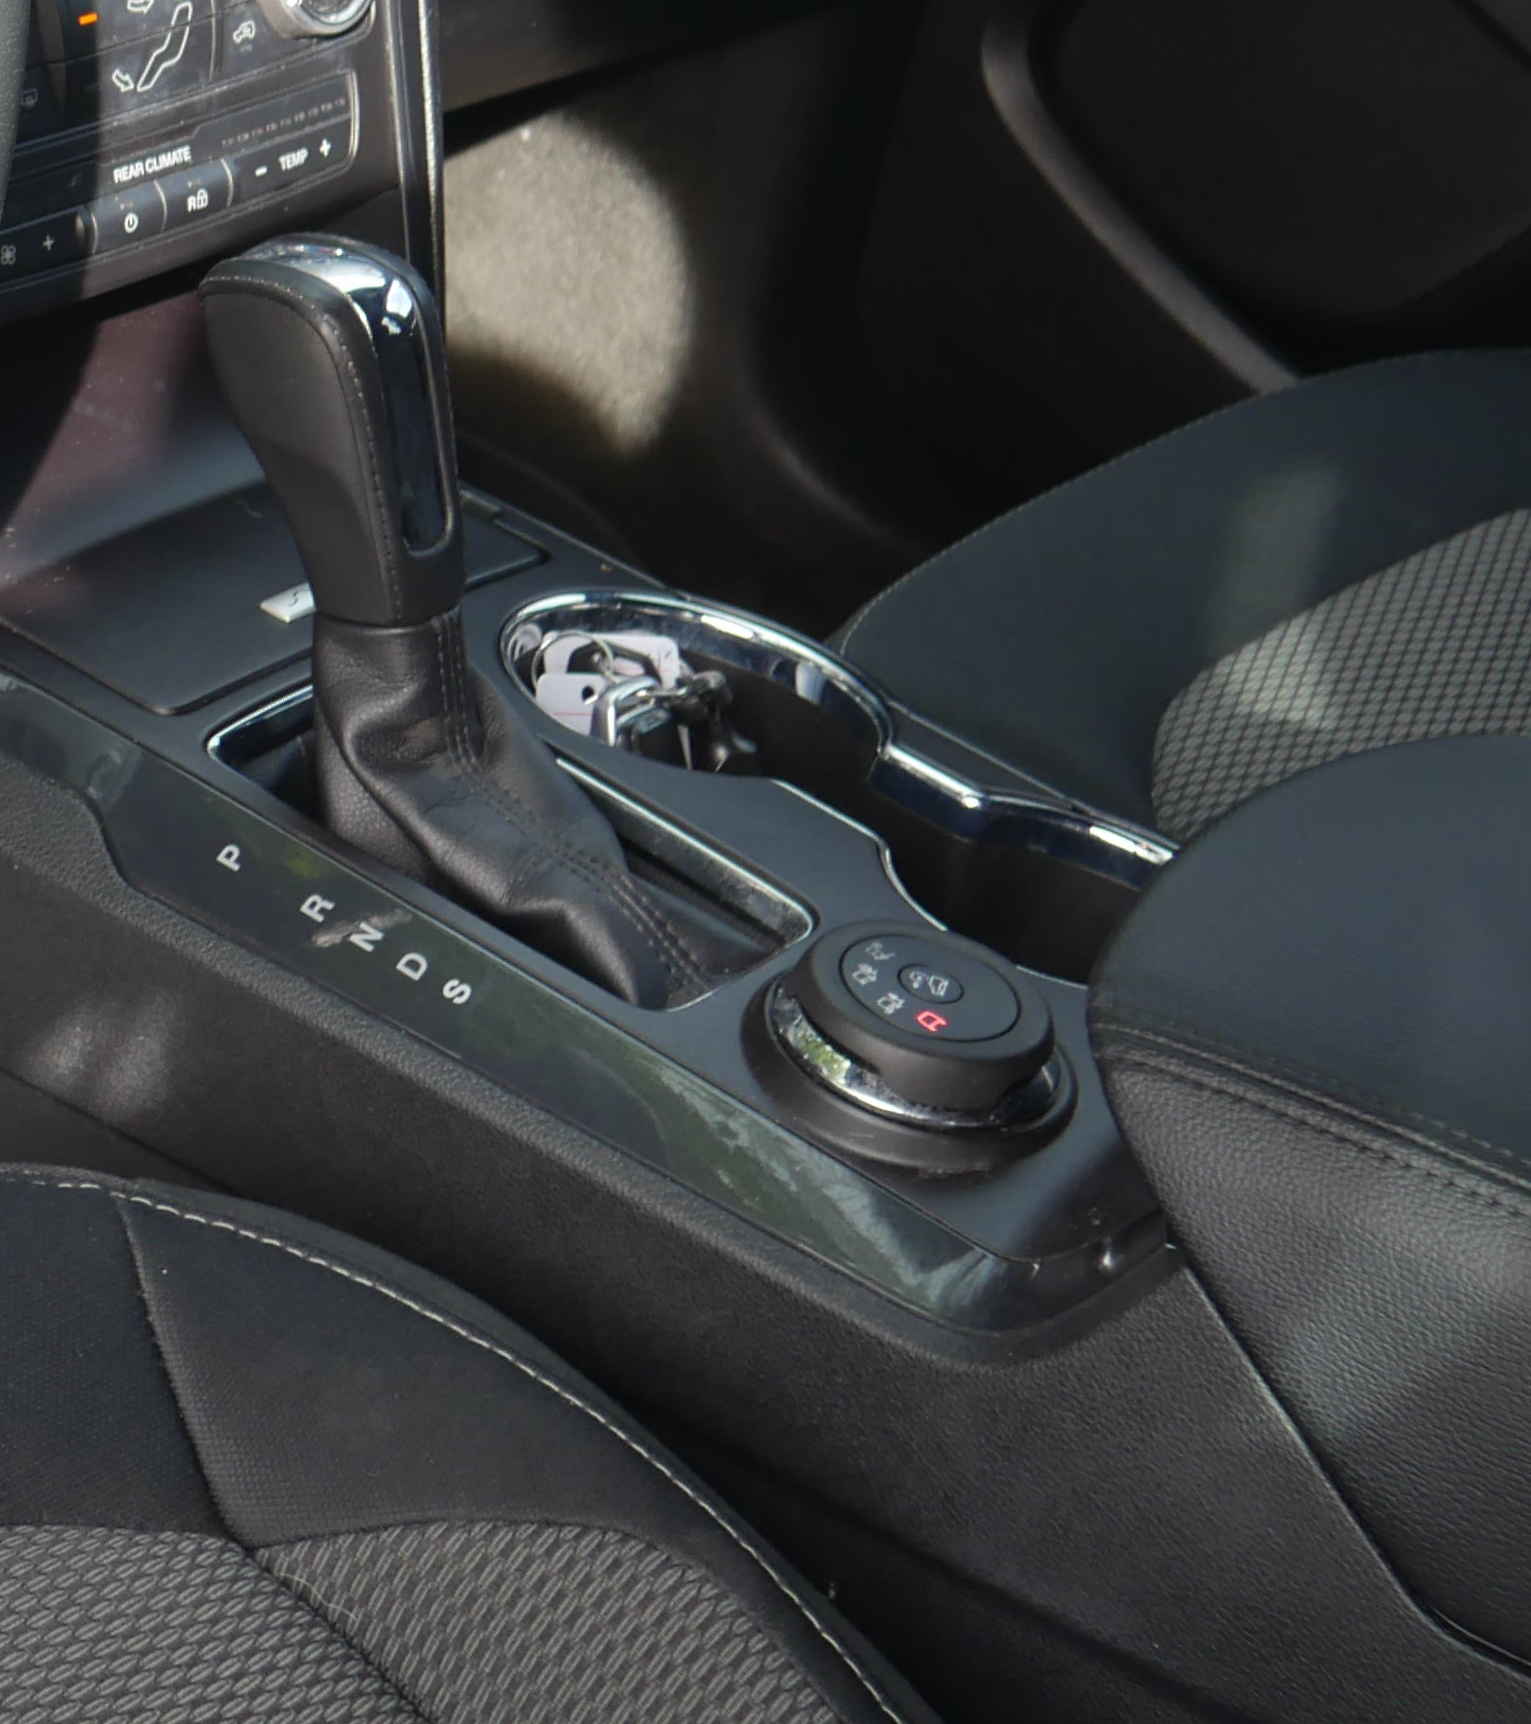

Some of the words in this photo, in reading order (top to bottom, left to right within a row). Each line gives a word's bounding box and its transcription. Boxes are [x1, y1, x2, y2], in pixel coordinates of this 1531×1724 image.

[113, 160, 144, 184] REAR
[145, 145, 192, 175] CLIMATE
[278, 148, 309, 172] TEMP
[216, 844, 241, 872] P
[299, 893, 335, 923] R
[349, 921, 384, 952] N
[395, 952, 428, 981] D
[442, 979, 472, 1005] S
